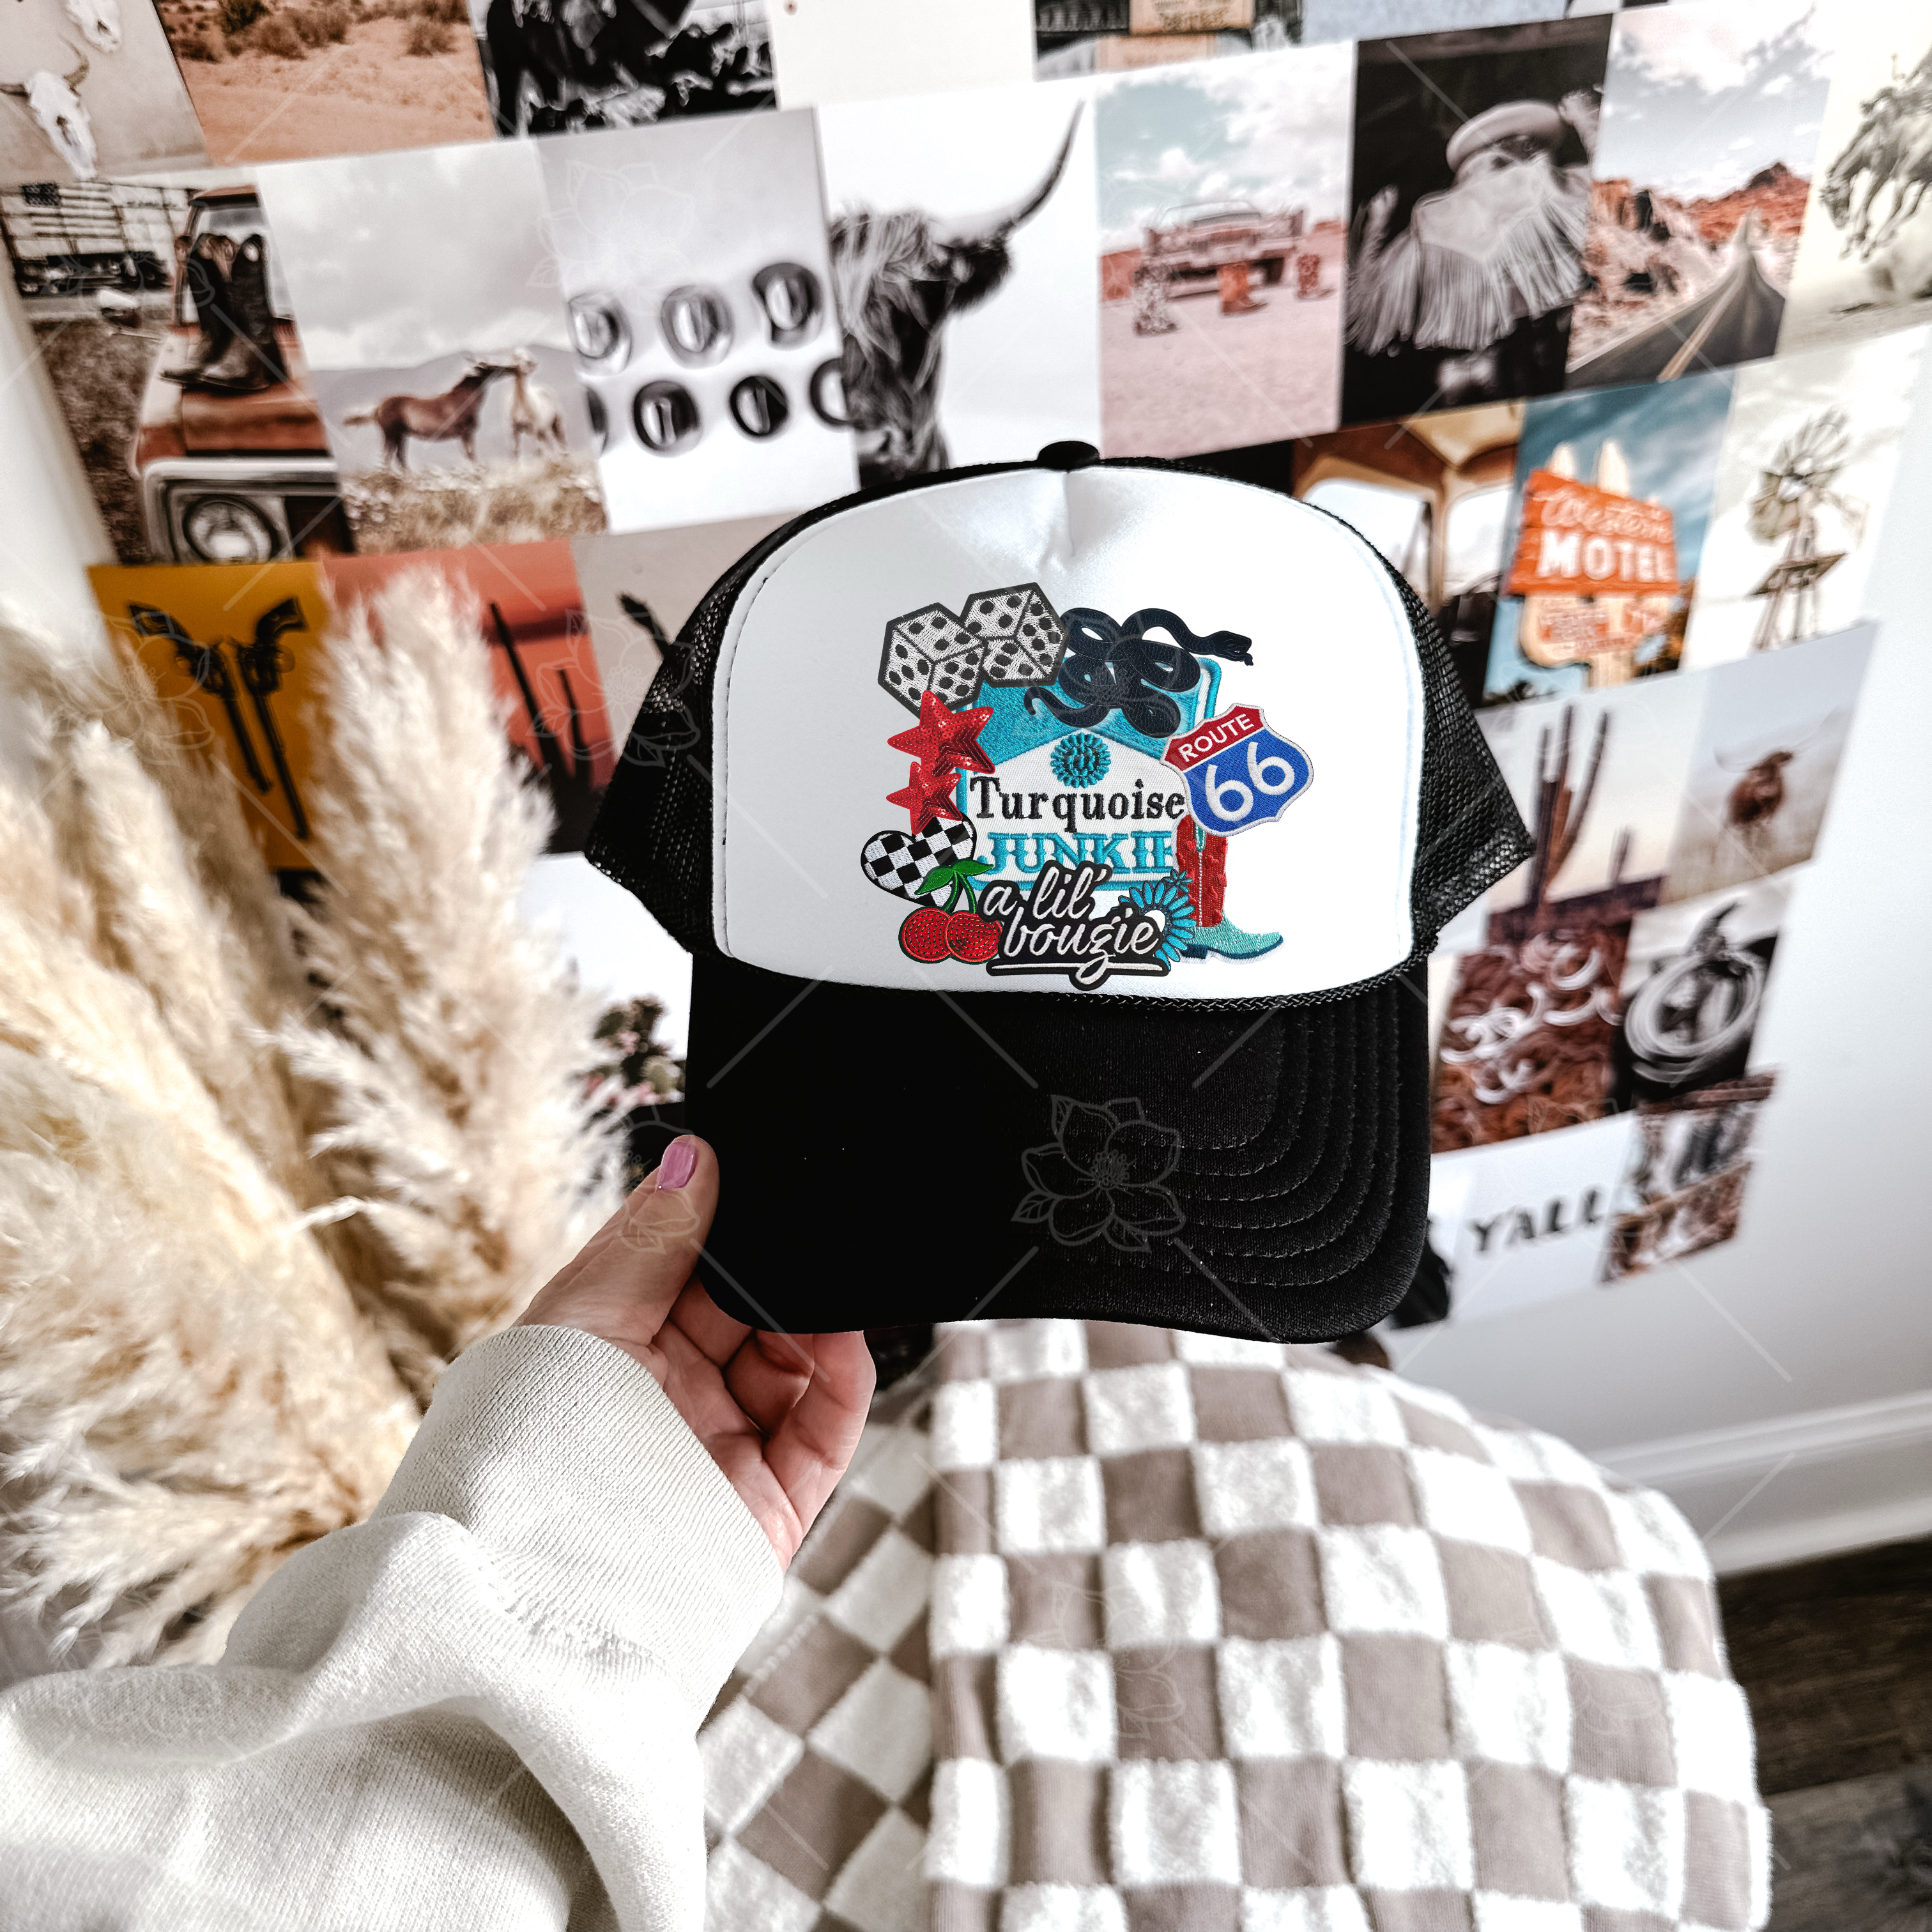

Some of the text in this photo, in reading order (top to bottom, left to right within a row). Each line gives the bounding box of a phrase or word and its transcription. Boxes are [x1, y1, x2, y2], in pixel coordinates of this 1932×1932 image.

[1535, 529, 1678, 583] MOTEL
[1177, 713, 1254, 763] ROUTE
[969, 776, 1185, 832] Turquoise
[1205, 741, 1295, 822] 66
[973, 830, 1173, 875] JUNKIE
[983, 866, 1107, 919] a lil'
[1004, 906, 1160, 985] bougie
